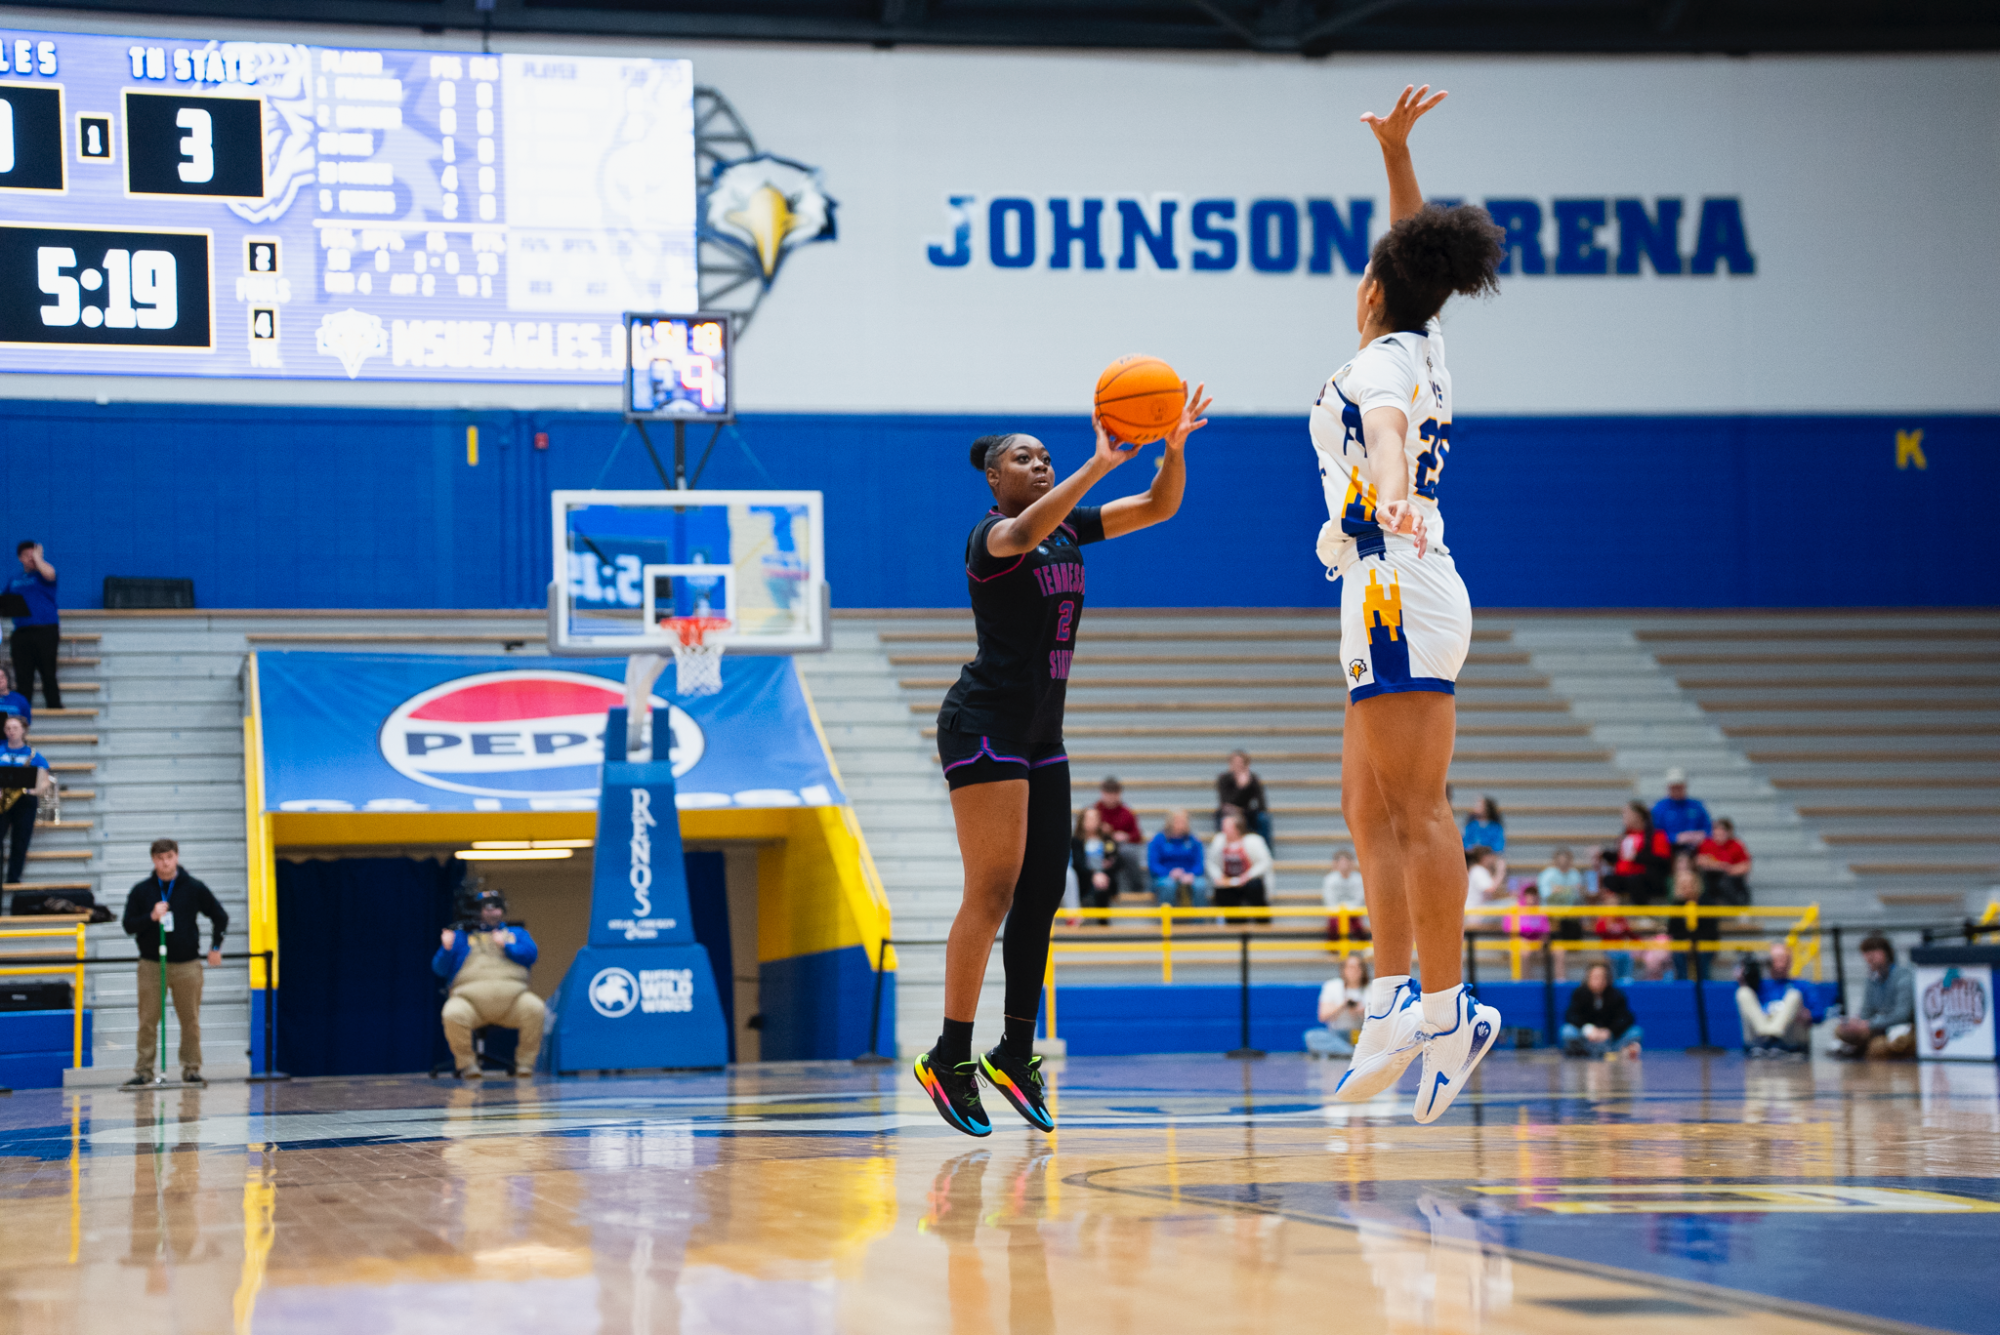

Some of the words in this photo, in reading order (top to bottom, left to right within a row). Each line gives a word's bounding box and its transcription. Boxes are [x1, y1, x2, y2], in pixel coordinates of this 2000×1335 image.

[130, 46, 166, 79] TN
[174, 48, 257, 83] STATE
[87, 125, 102, 154] 1
[176, 107, 214, 183] 3
[927, 196, 1374, 274] JOHNSON
[37, 246, 178, 329] 5:19
[1896, 429, 1927, 470] K
[1056, 600, 1075, 641] 2
[404, 731, 680, 757] PEP
[630, 787, 658, 918] RENOS
[640, 981, 693, 999] WILD
